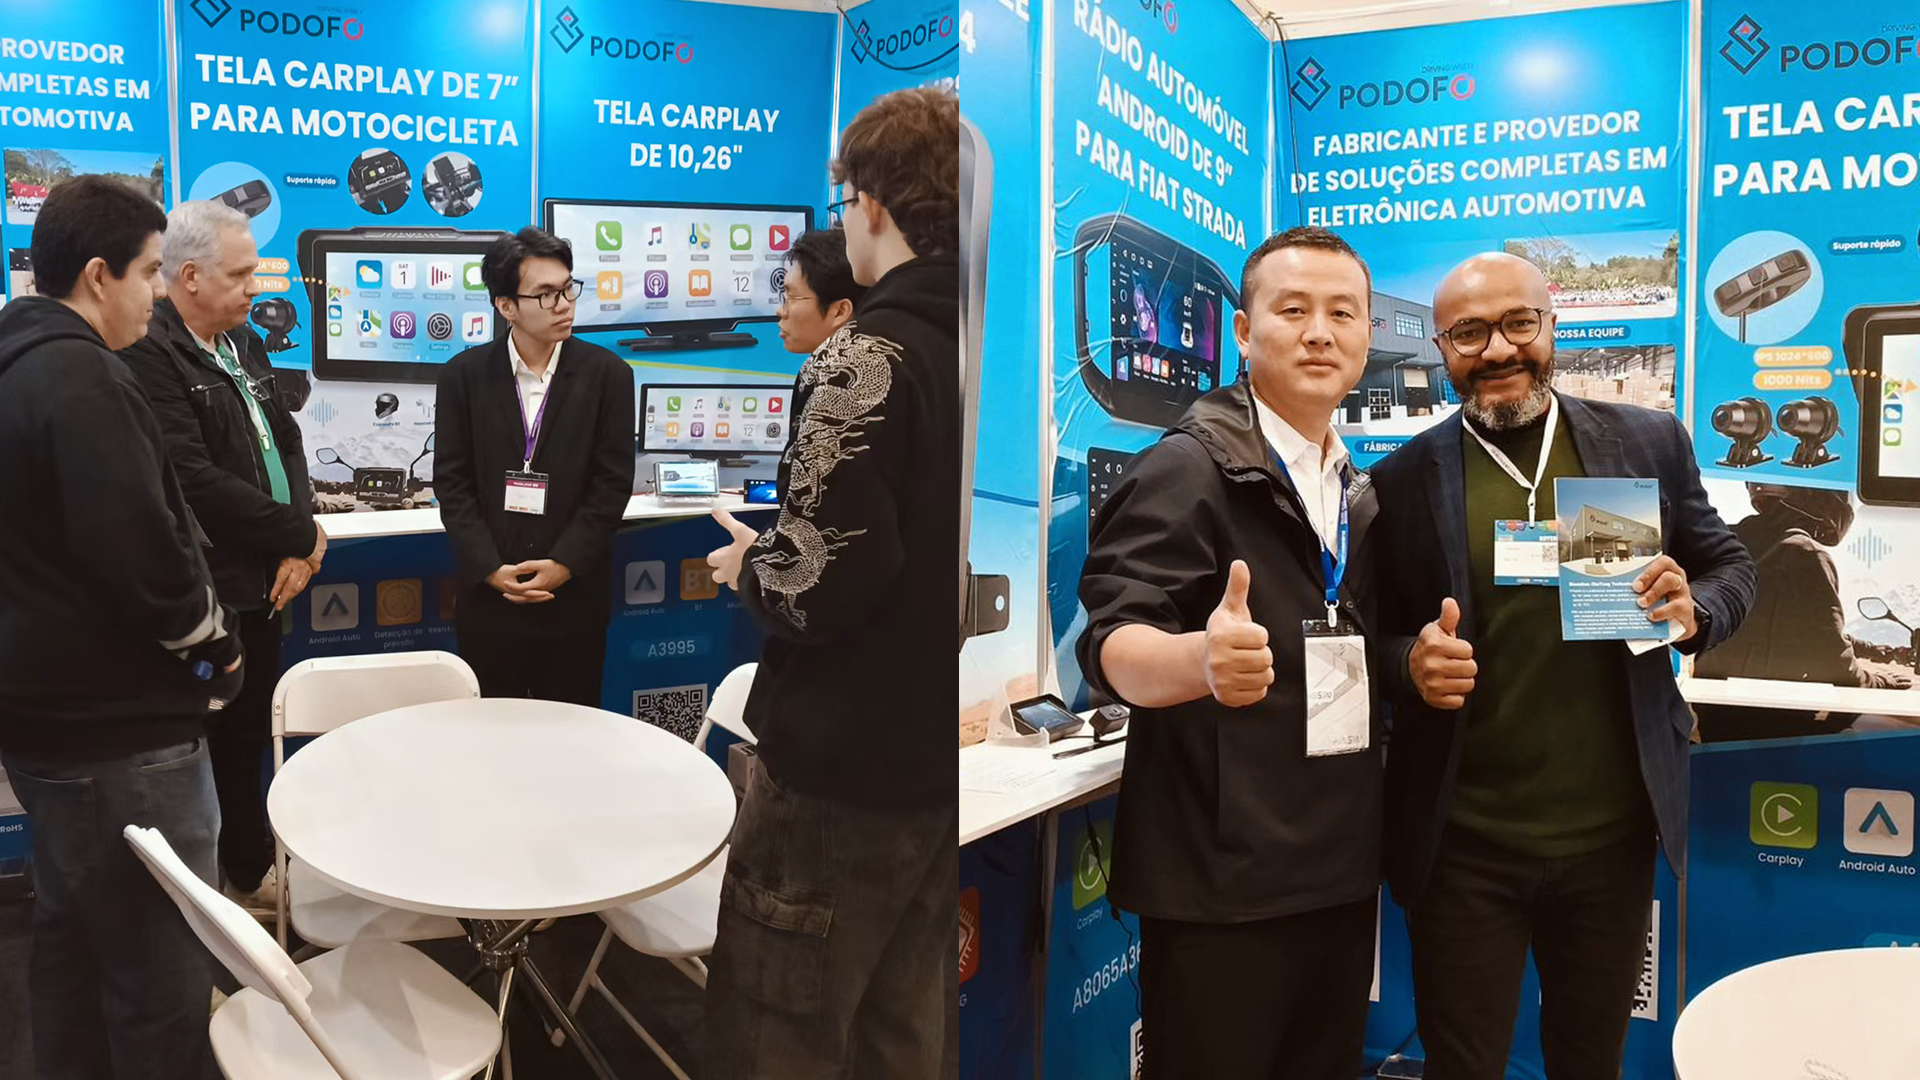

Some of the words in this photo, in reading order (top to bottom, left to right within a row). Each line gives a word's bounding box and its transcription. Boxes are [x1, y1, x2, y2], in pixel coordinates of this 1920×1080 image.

[241, 10, 364, 41] PODOFO
[877, 15, 953, 58] PODOFO
[0, 37, 124, 64] ROVEDOR
[590, 35, 694, 64] PODOFO
[1780, 35, 1920, 72] PODOF
[115, 79, 150, 99] EM
[195, 53, 276, 87] TELA
[284, 60, 434, 96] CARPLAY
[442, 71, 480, 99] DE
[1339, 73, 1476, 109] PODOFO
[593, 99, 655, 127] TELA
[661, 103, 780, 133] CARPLAY
[1147, 52, 1250, 156] AUTOMÓVEL
[1722, 100, 1824, 139] TELA
[190, 102, 284, 134] PARA
[291, 108, 519, 147] MOTOCICLETA
[1097, 74, 1190, 162] ANDROID
[1192, 139, 1213, 181] DE
[1313, 124, 1468, 157] FABRICANTE
[1474, 122, 1487, 144] E
[1494, 110, 1641, 143] PROVEDOR
[630, 142, 662, 168] DE
[668, 143, 743, 174] 10,26"
[1290, 171, 1320, 194] DE
[1325, 158, 1455, 194] SOLUÇÕES
[1461, 149, 1620, 182] COMPLETAS
[1627, 146, 1667, 170] EM
[1713, 158, 1831, 197] PARA
[1843, 151, 1920, 190] MO
[1076, 119, 1135, 187] PARA
[1138, 159, 1180, 211] FIAT
[1182, 187, 1247, 251] STRADA
[1307, 197, 1459, 228] ELETRÔNICA
[1462, 185, 1646, 219] AUTOMOTIVA
[1833, 241, 1868, 252] Suporte
[1870, 239, 1901, 250] rápido
[734, 276, 750, 293] 12
[1589, 327, 1625, 339] EQUIPE
[308, 635, 341, 645] Android
[342, 633, 361, 642] Auto
[647, 640, 696, 657] A3995
[1757, 852, 1804, 868] Carplay
[1839, 859, 1885, 873] Android
[1888, 864, 1916, 876] Auto
